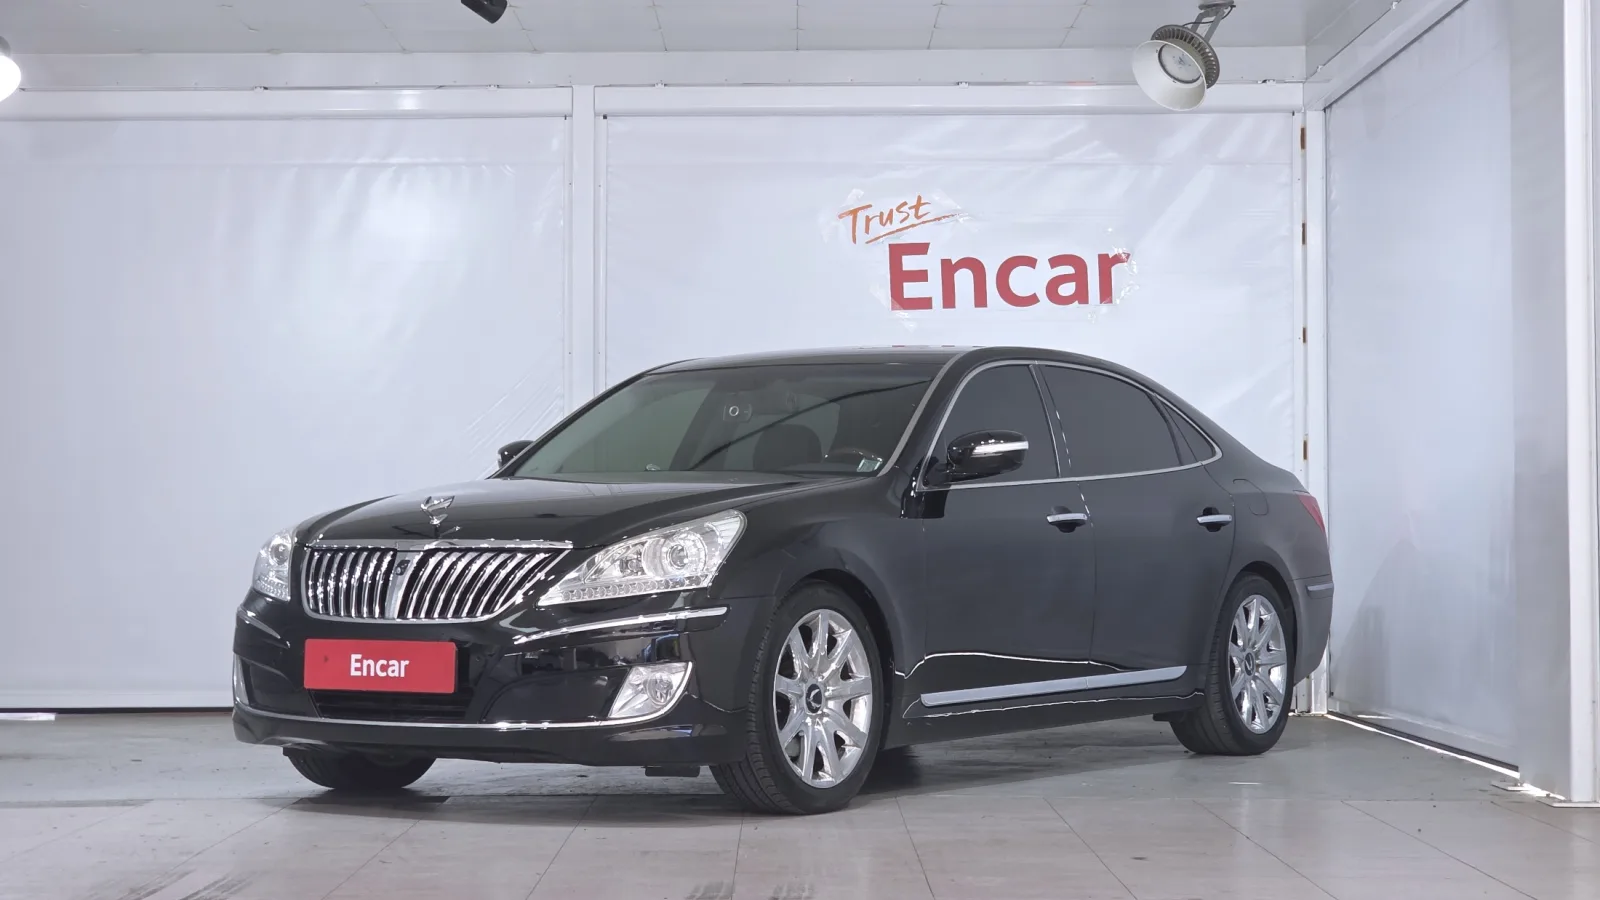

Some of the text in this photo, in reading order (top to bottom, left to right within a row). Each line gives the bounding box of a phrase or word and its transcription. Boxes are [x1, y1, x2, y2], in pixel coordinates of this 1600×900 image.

[838, 195, 931, 244] Trust
[888, 242, 1131, 310] Encar
[350, 653, 410, 678] Encar
